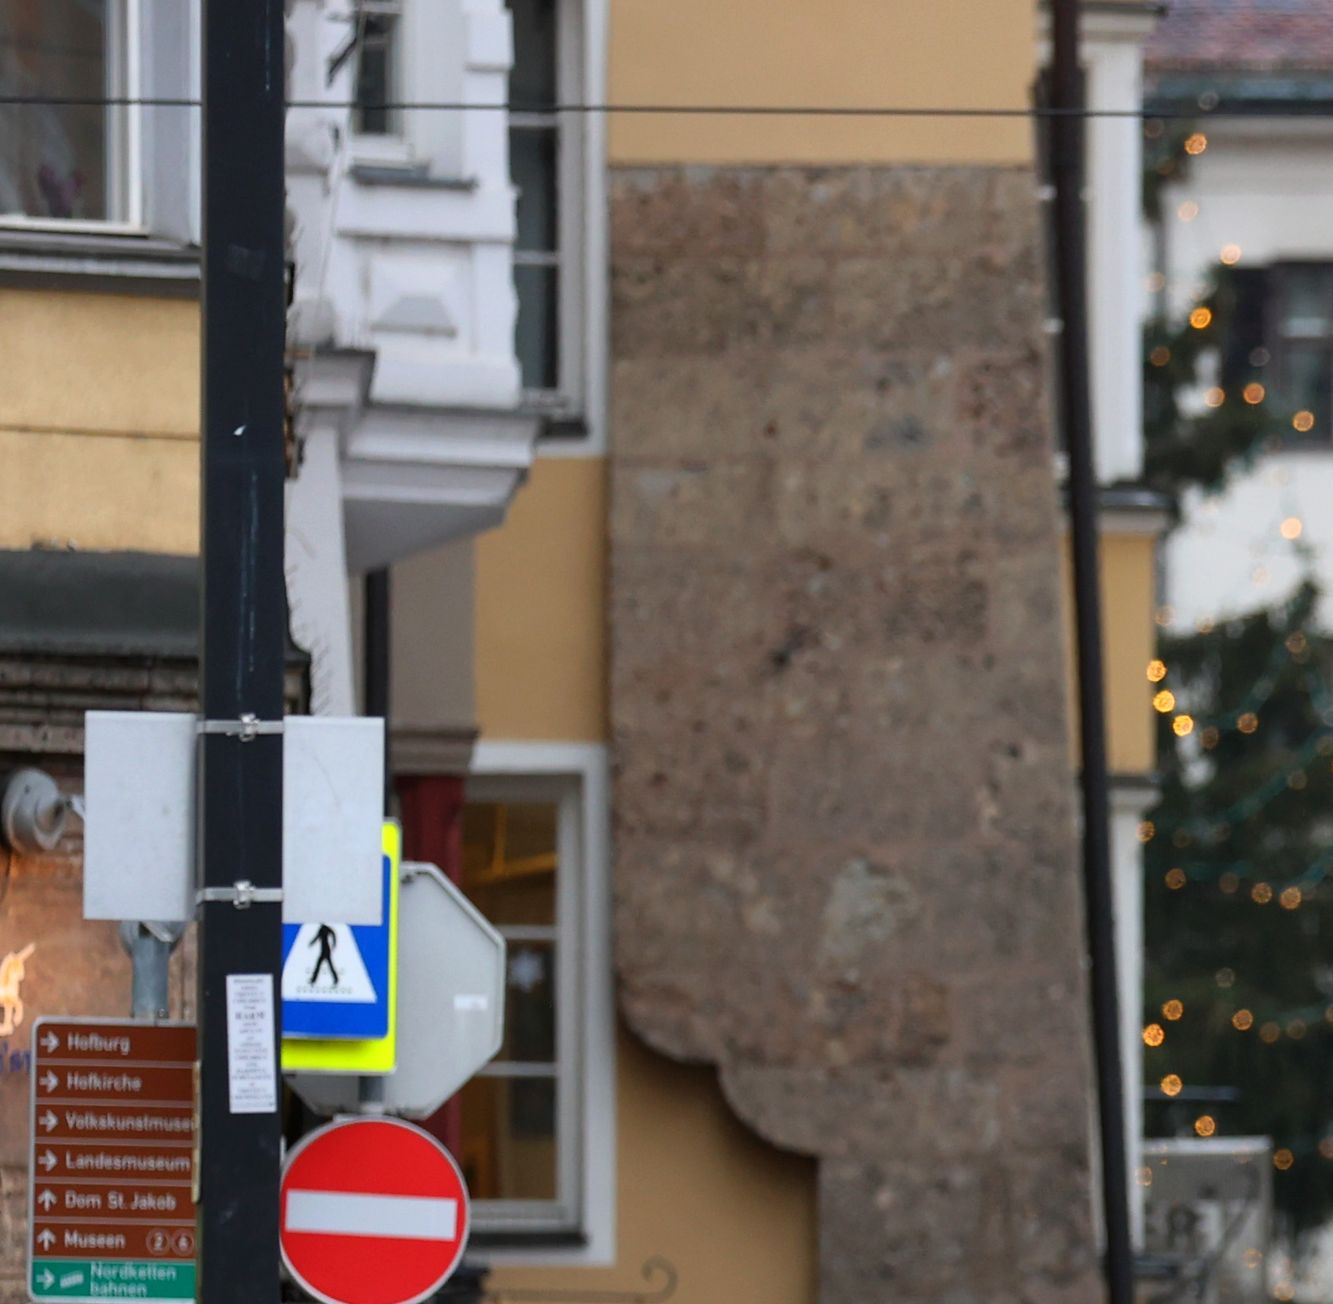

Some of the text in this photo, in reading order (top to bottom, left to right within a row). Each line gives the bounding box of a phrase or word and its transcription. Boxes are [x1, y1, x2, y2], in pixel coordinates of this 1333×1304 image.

[67, 1031, 131, 1055] Hofburg
[67, 1070, 142, 1092] Hofkirche
[65, 1151, 191, 1171] Landesmuseum
[65, 1190, 102, 1209] Dom
[129, 1192, 177, 1210] Jakob
[64, 1229, 126, 1249] Museen
[89, 1260, 177, 1281] Nordketten
[89, 1281, 148, 1298] bahnen
